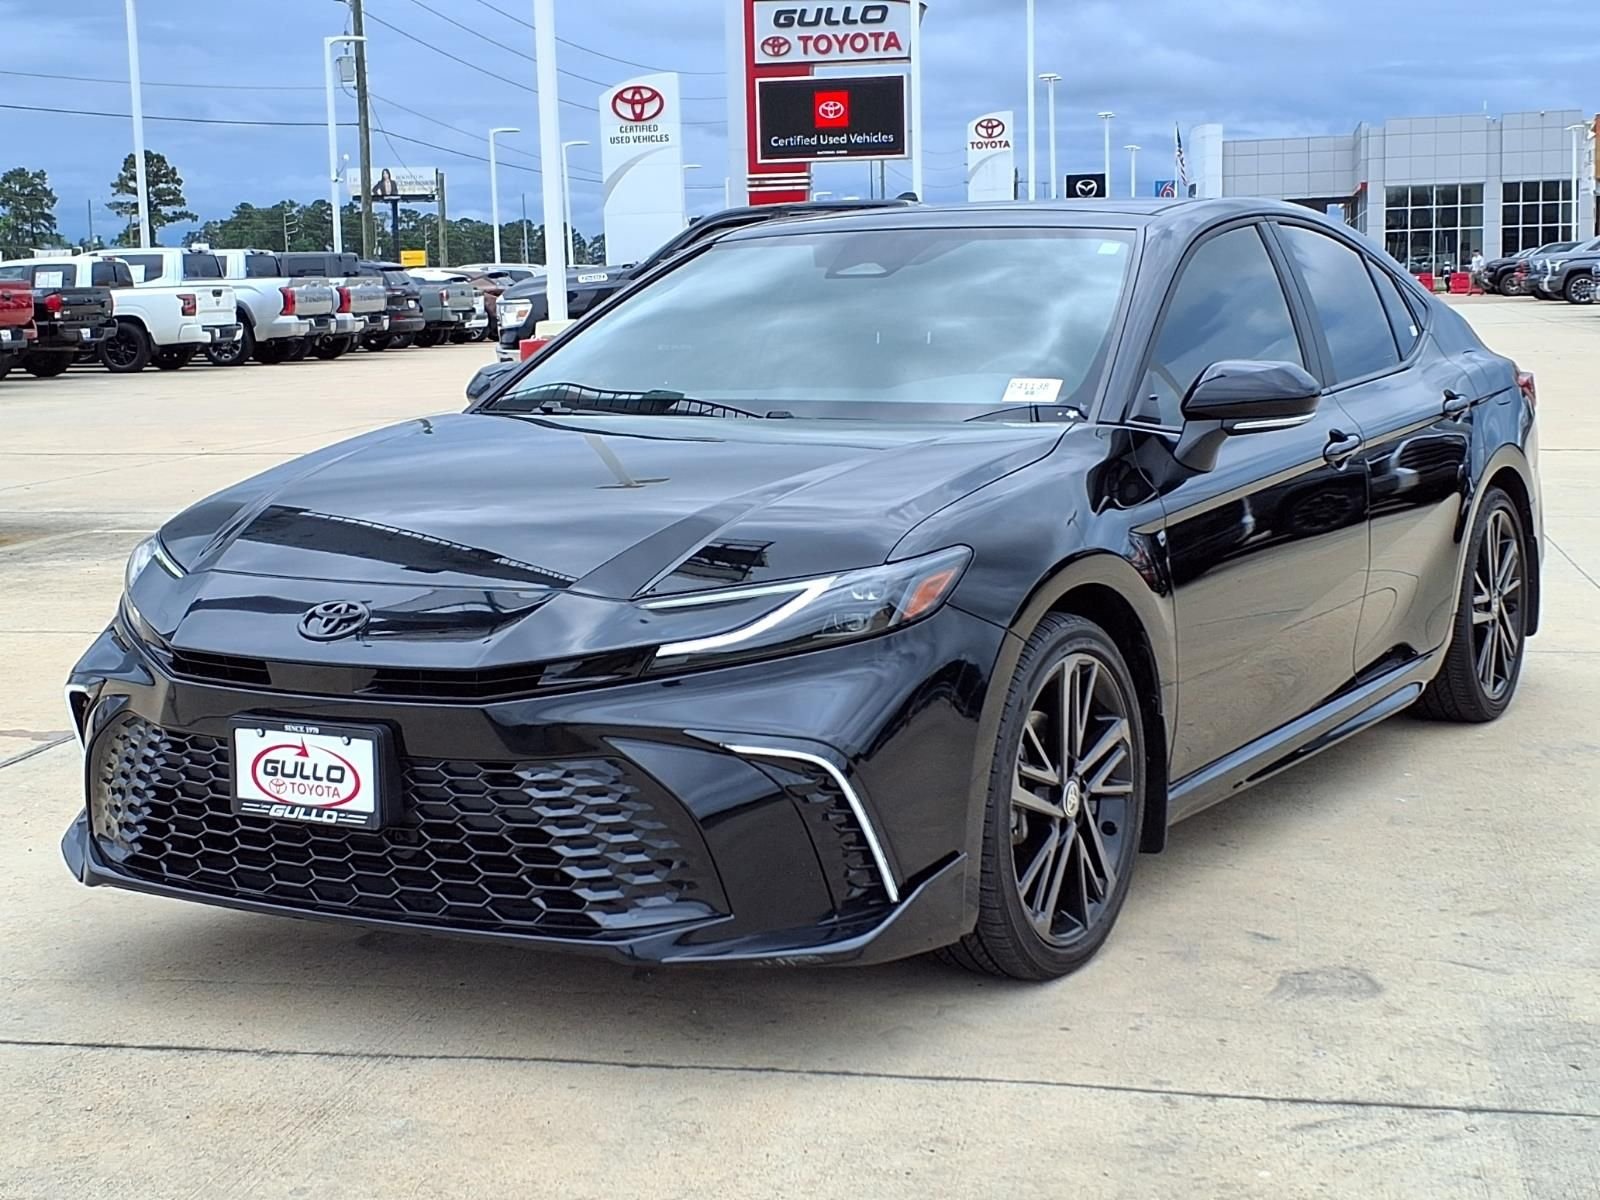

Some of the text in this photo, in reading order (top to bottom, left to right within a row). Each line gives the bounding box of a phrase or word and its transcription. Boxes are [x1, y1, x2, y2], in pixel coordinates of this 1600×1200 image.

[773, 5, 888, 28] GULLO
[797, 31, 902, 55] TOYOTA
[619, 124, 659, 134] CERTIFIED
[609, 134, 670, 145] USED VEHICLES
[770, 132, 894, 147] Certified Used Vehicles
[970, 140, 1011, 150] TOYOTA
[283, 724, 305, 733] SINCE
[263, 758, 346, 784] GULLO
[289, 782, 341, 799] TOYOTA
[268, 804, 339, 824] GULLO
